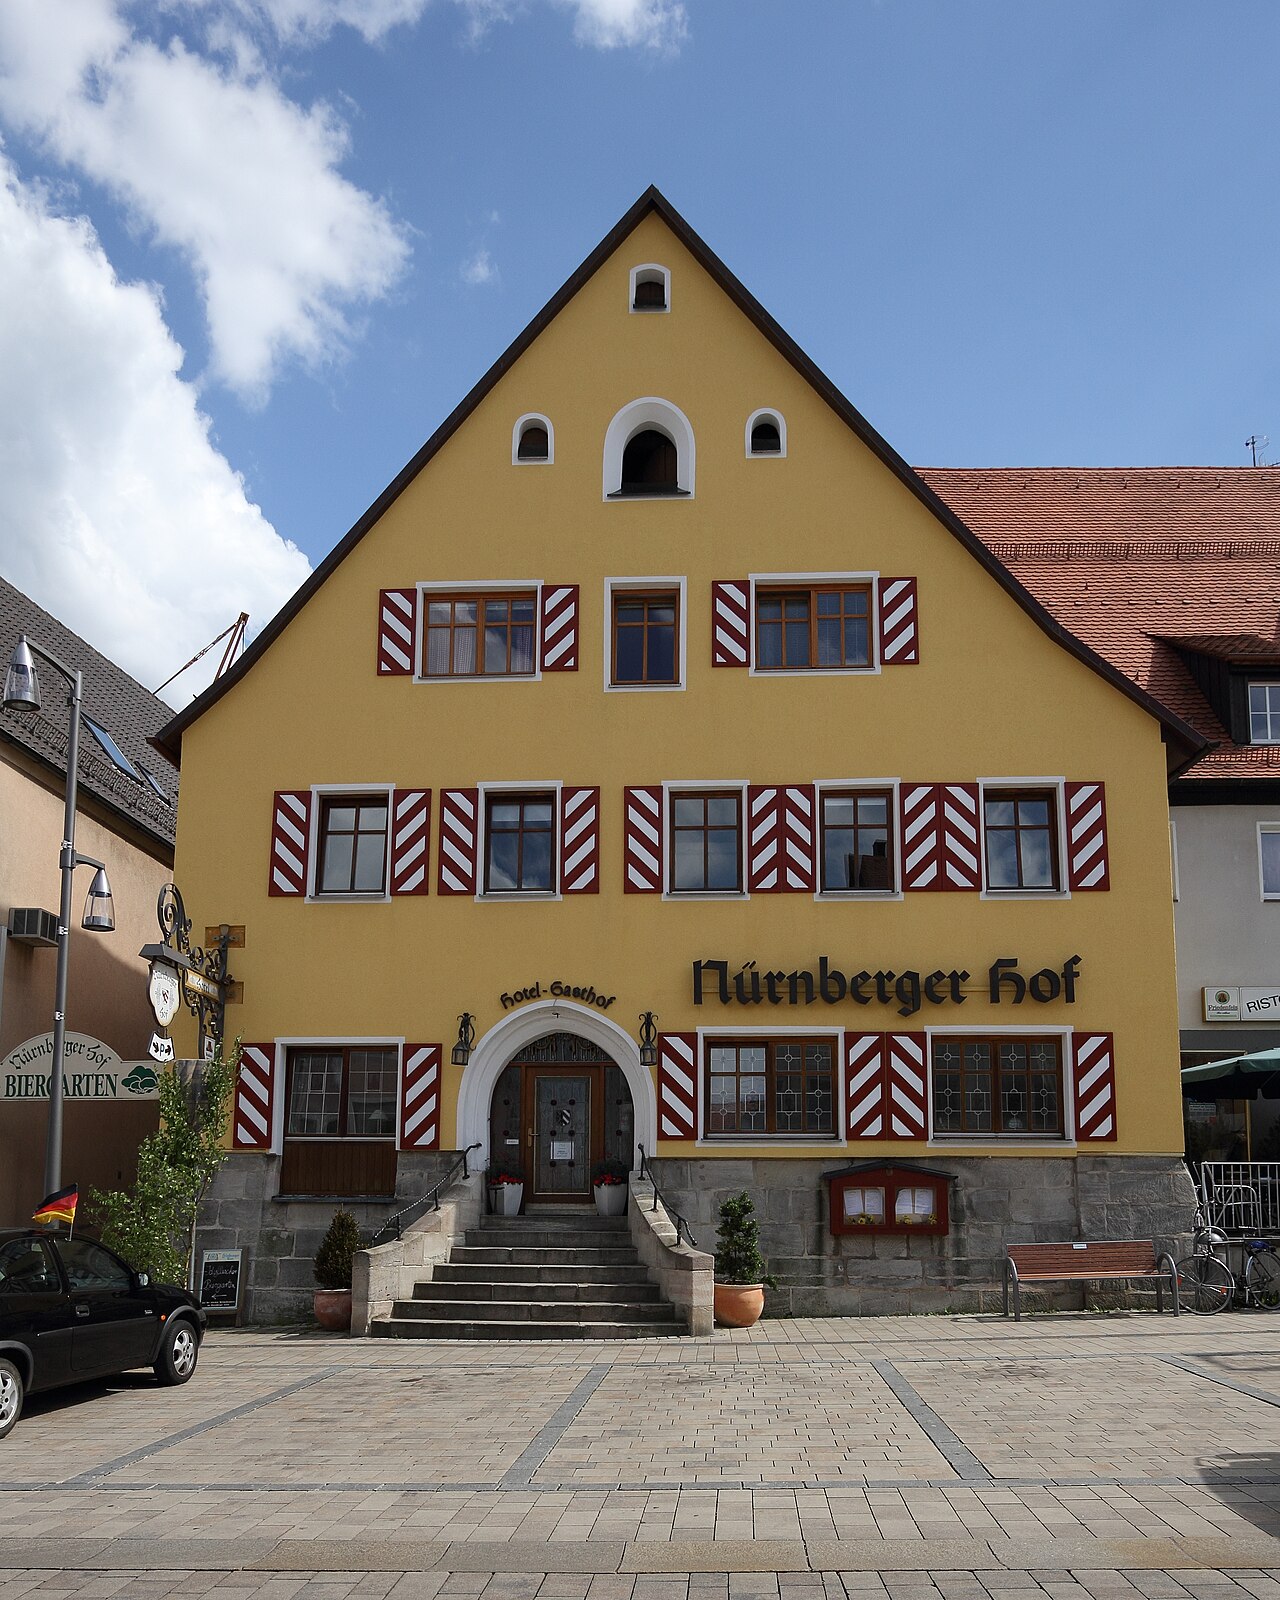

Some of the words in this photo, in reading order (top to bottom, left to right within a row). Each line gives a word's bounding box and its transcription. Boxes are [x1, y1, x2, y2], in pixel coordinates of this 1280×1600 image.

[692, 956, 971, 1018] Nürnberger
[988, 953, 1083, 1005] Hof
[1246, 994, 1280, 1013] RIST
[9, 1037, 86, 1070] Nürnbger
[86, 1044, 112, 1071] Hof
[159, 1043, 166, 1057] P
